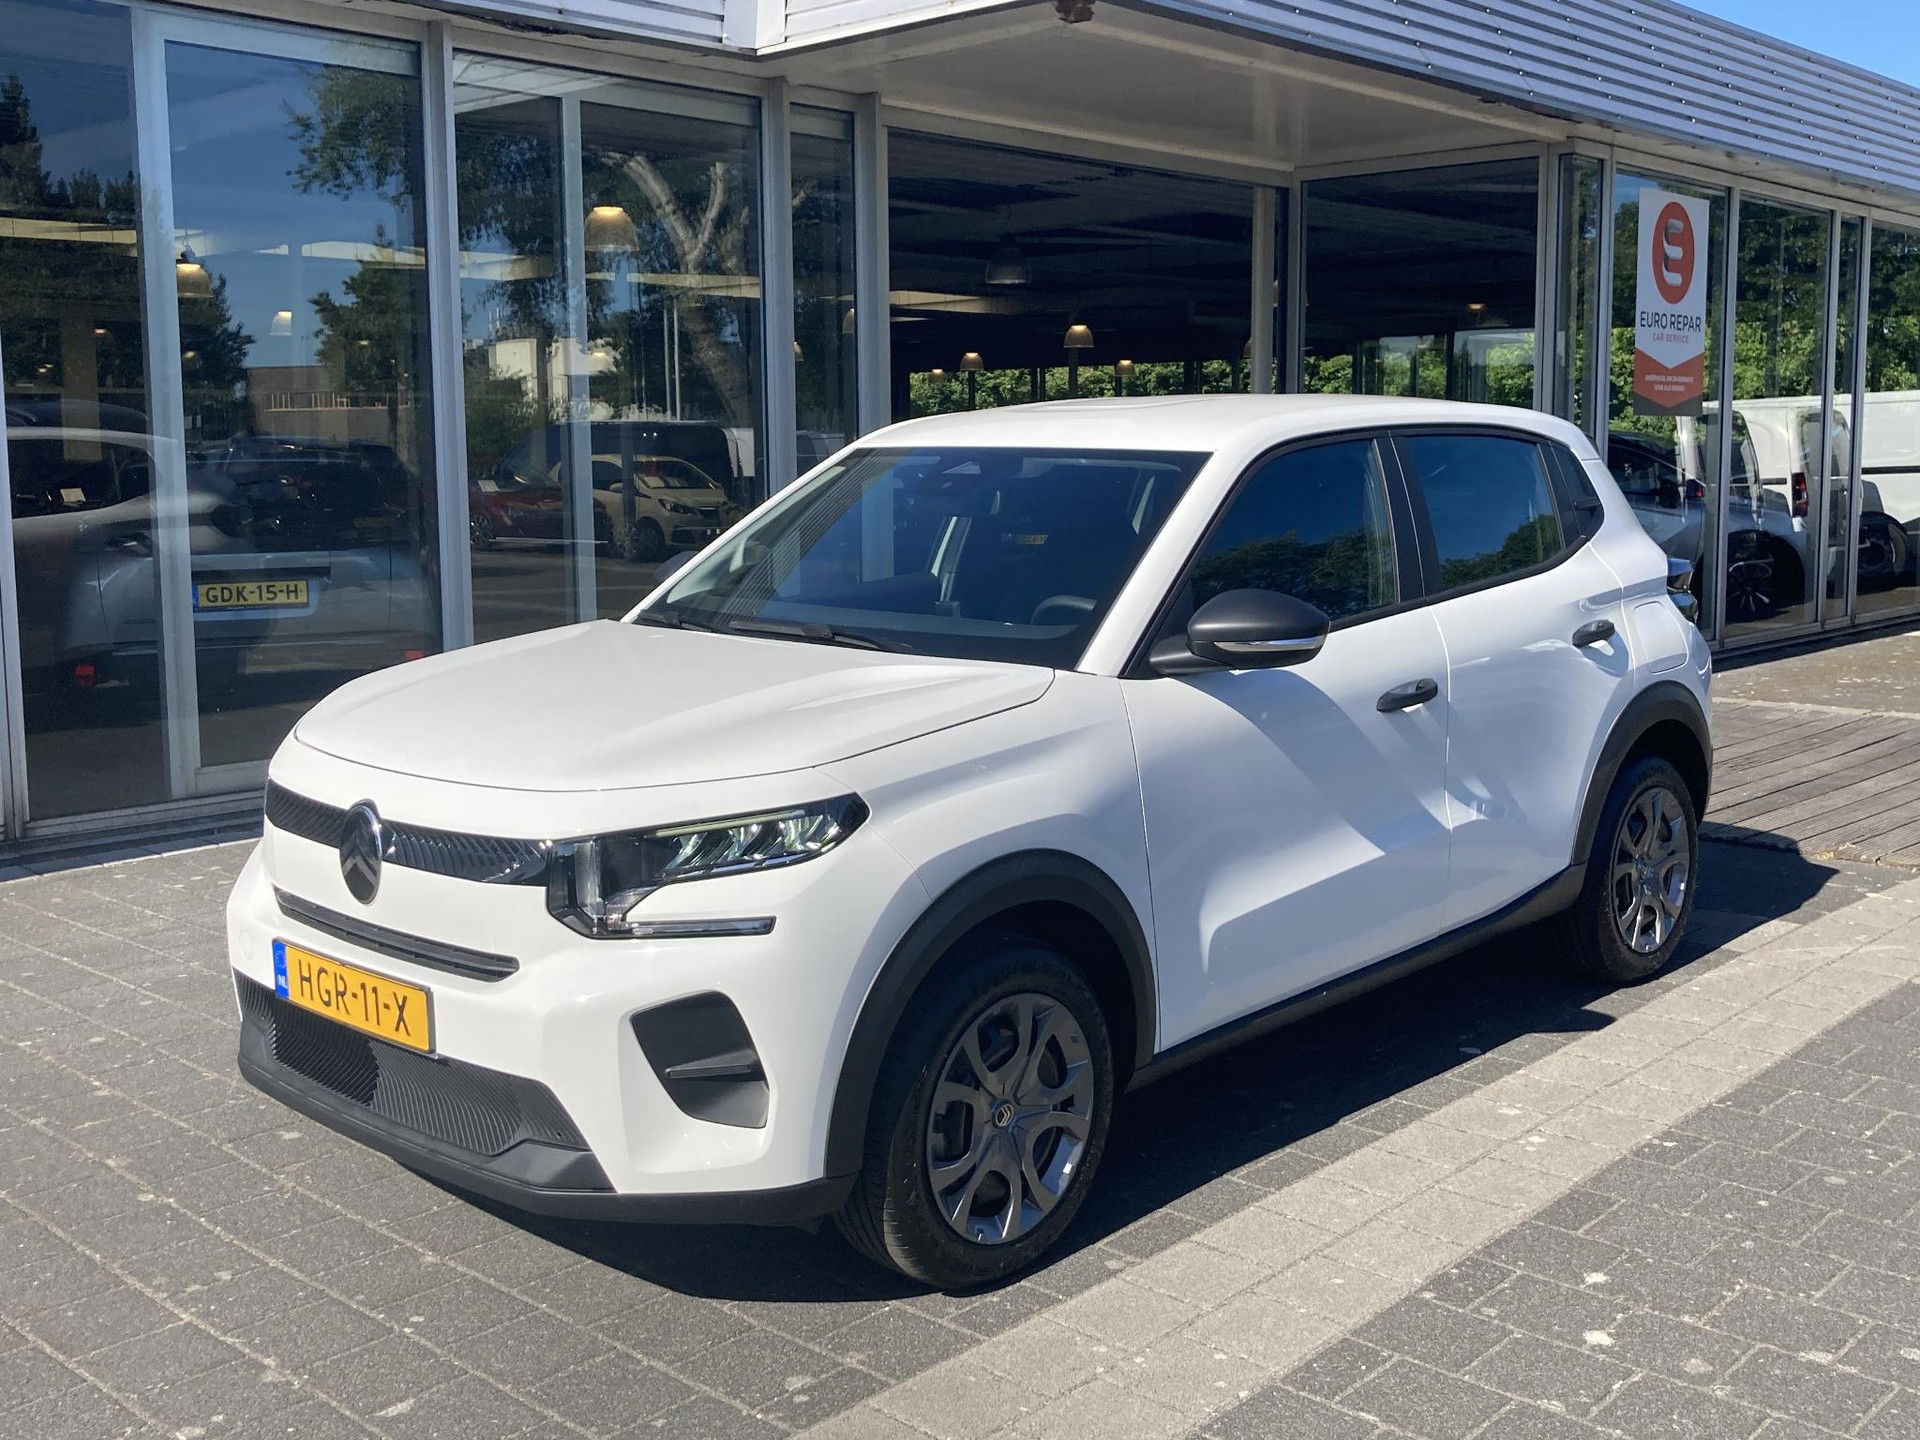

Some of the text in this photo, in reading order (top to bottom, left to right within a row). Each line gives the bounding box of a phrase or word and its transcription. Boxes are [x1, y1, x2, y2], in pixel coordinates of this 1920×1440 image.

[1640, 311, 1702, 332] EURO REPAR
[206, 584, 299, 603] GDK-15-H
[298, 959, 411, 1037] HGR-11-X
